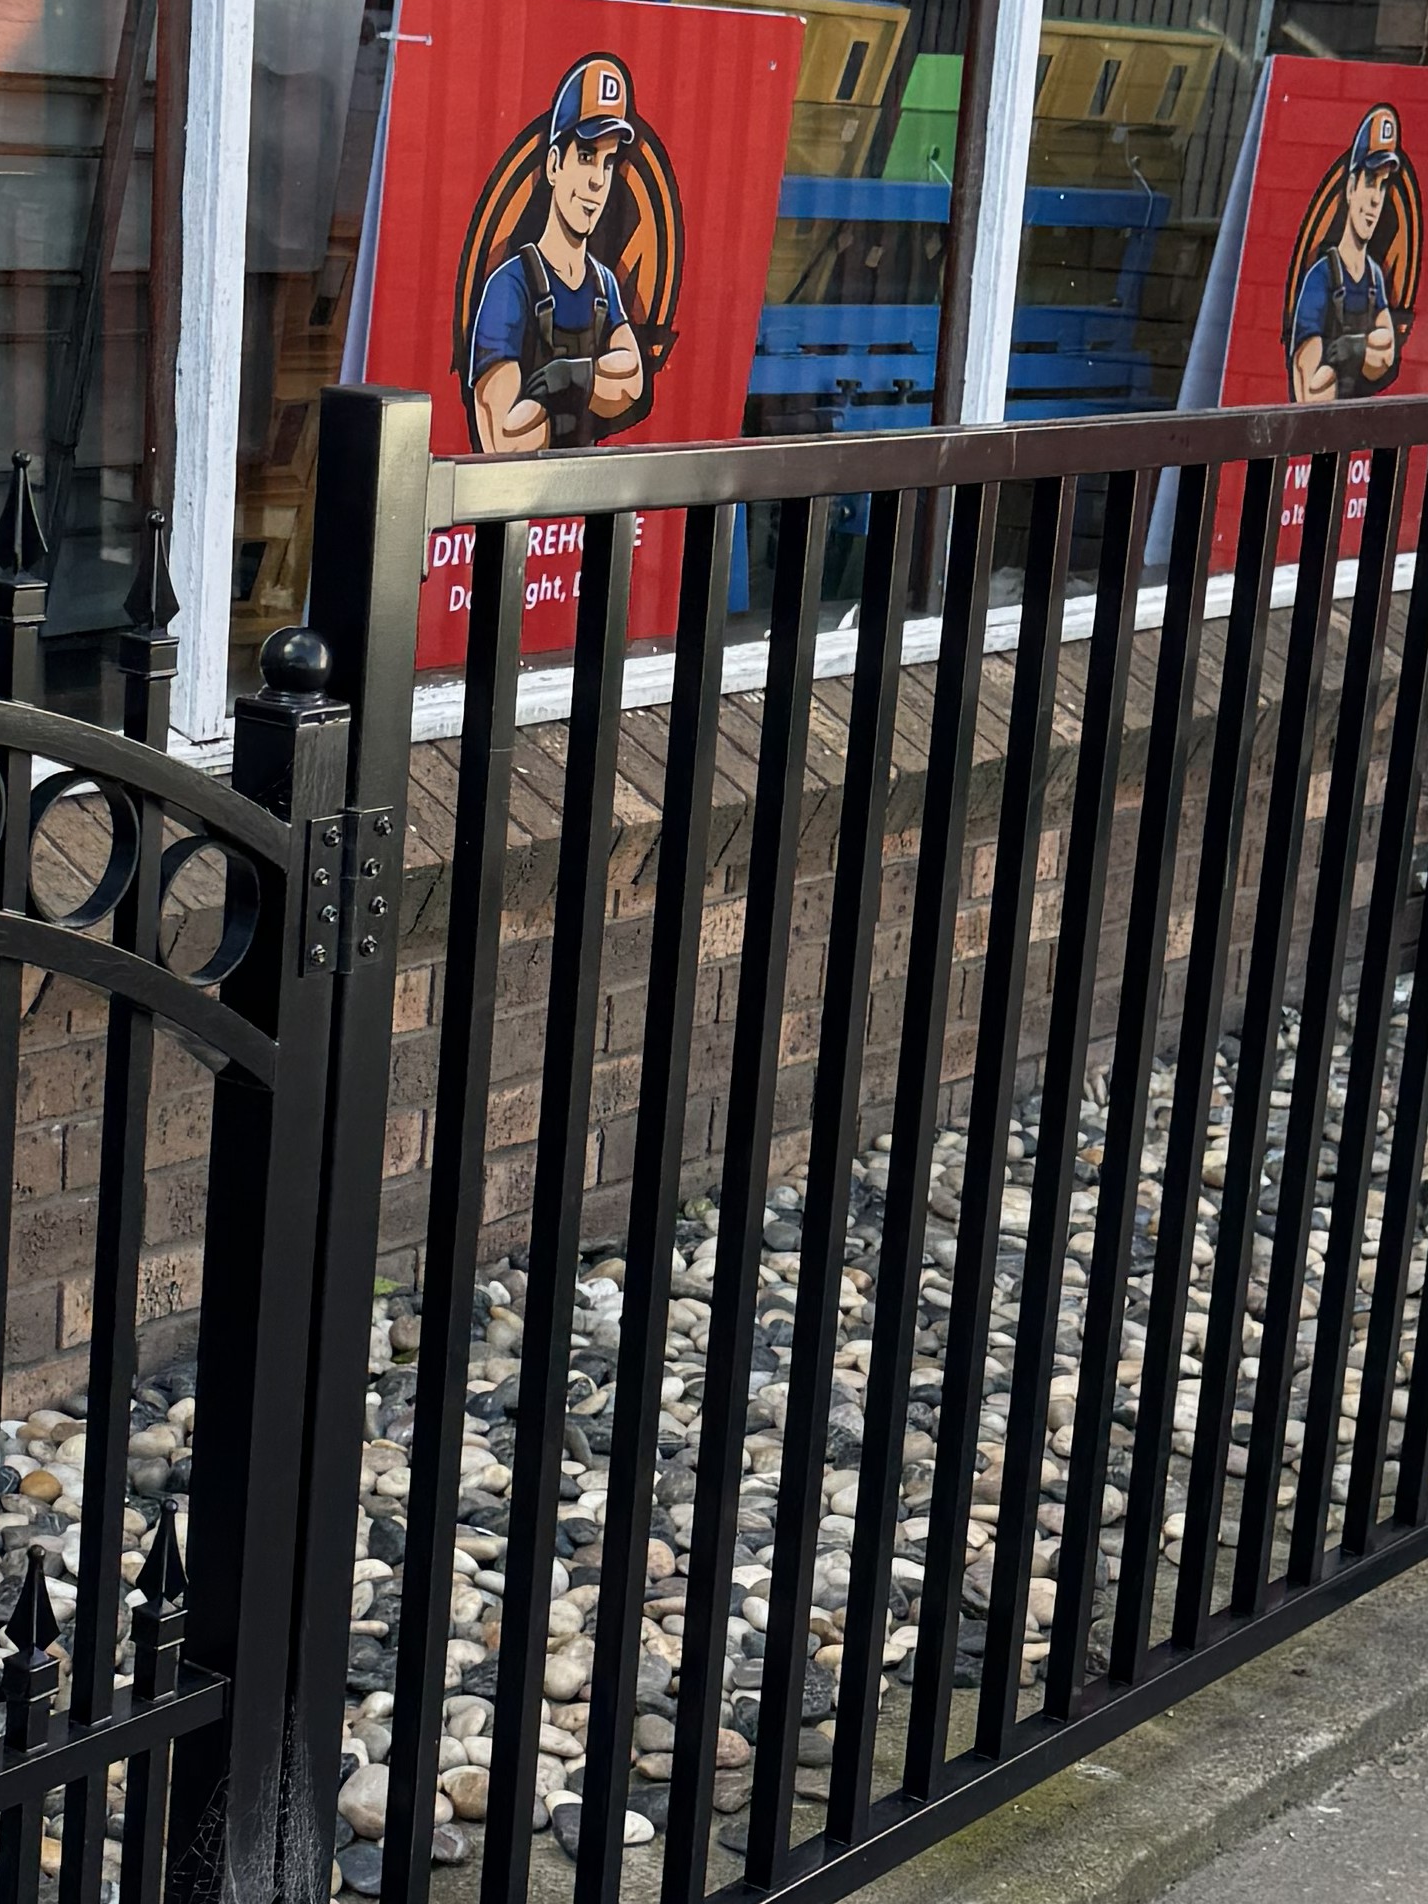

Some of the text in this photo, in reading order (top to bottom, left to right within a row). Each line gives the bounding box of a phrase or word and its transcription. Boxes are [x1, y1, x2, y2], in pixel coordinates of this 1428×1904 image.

[598, 70, 623, 106] D
[1380, 117, 1396, 143] D
[525, 573, 566, 610] ght,
